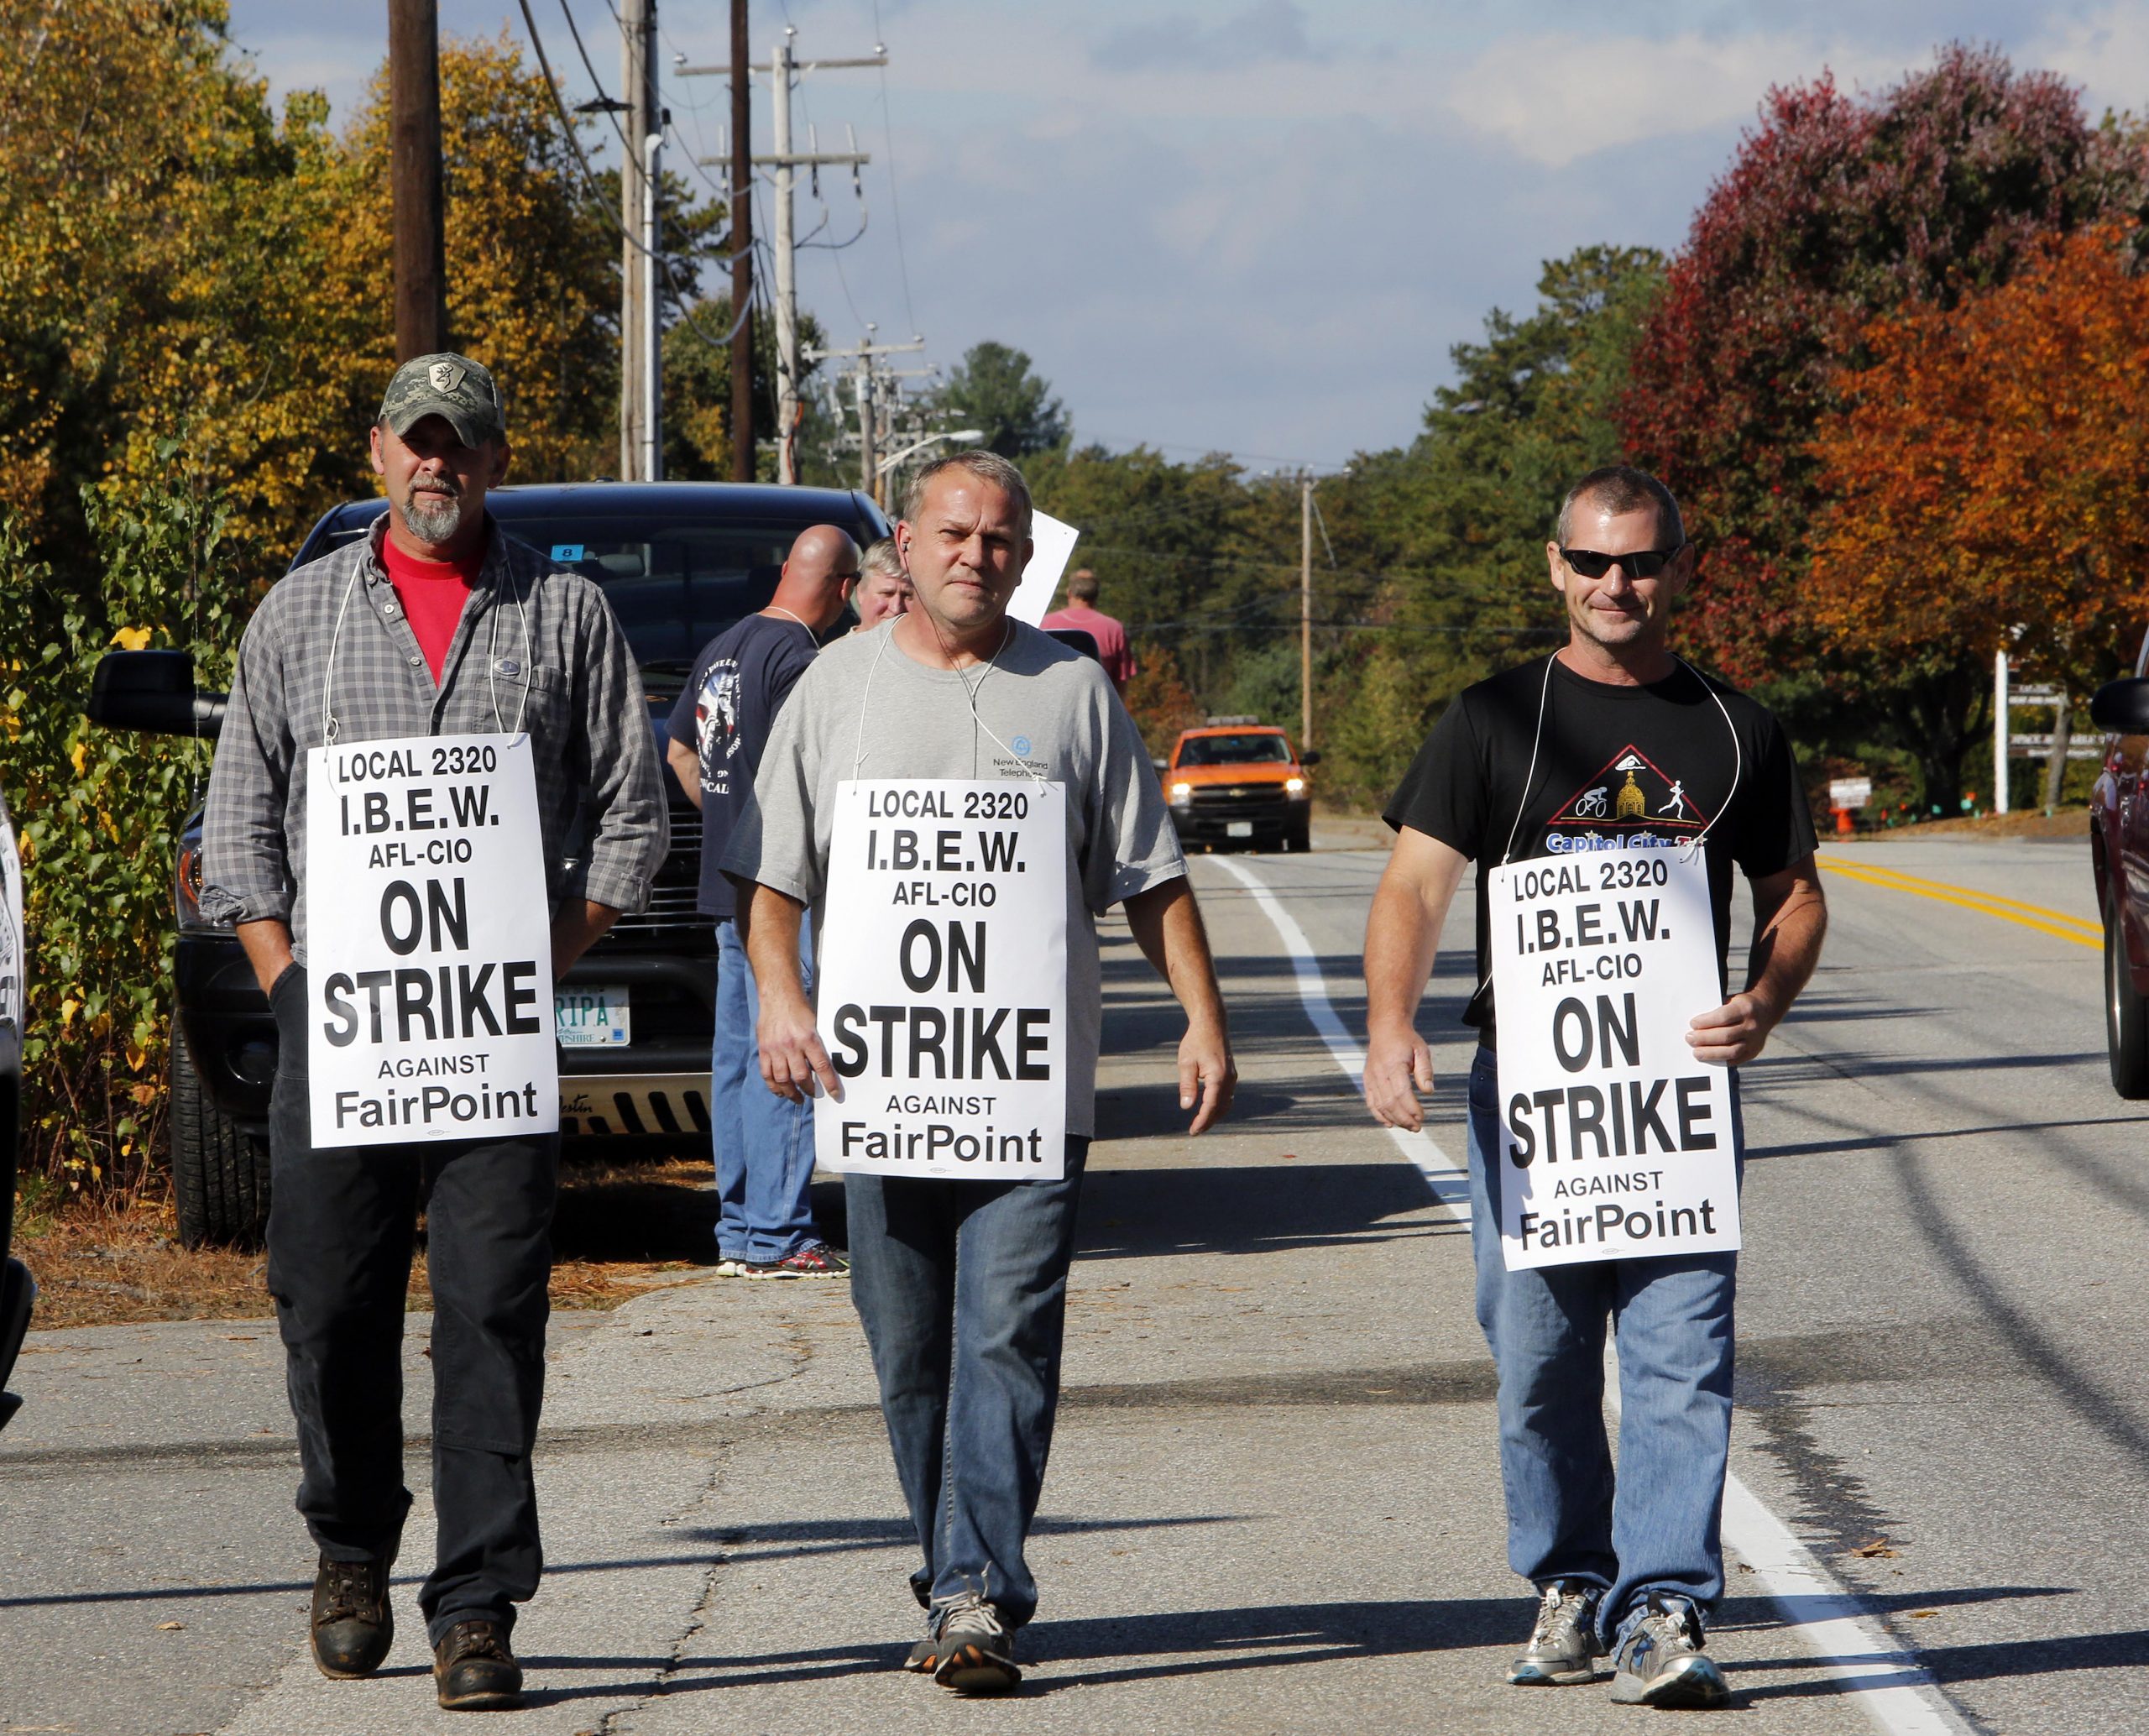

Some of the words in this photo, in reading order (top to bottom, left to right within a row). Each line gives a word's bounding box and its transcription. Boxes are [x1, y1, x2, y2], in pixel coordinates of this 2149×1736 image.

[562, 548, 573, 557] 8
[339, 749, 422, 782] LOCAL
[431, 745, 497, 776] 2320
[993, 758, 1014, 766] New
[341, 784, 499, 836] I.B.E.W.
[869, 790, 954, 818] LOCAL
[964, 792, 1028, 820] 2320
[369, 838, 473, 869] AFL-CIO
[868, 829, 1026, 873] I.B.E.W.
[1546, 830, 1623, 854] Capitol
[892, 881, 996, 907] AFL-CIO
[1514, 865, 1591, 902] LOCAL
[1600, 859, 1668, 890] 2320
[380, 877, 469, 956] ON
[1517, 899, 1671, 955] I.B.E.W.
[900, 918, 986, 994] ON
[1542, 953, 1642, 986] AFL-CIO
[324, 960, 541, 1047] STRIKE
[831, 1003, 1051, 1081] STRIKE
[1553, 992, 1640, 1073] ON
[378, 1054, 489, 1079] AGAINST
[336, 1081, 538, 1128] FairPoint
[559, 1094, 593, 1114] estin
[886, 1095, 996, 1115] AGAINST
[1508, 1075, 1717, 1170] STRIKE
[842, 1122, 1042, 1163] FairPoint
[1555, 1171, 1663, 1199] AGAINST
[1519, 1199, 1717, 1251] FairPoint
